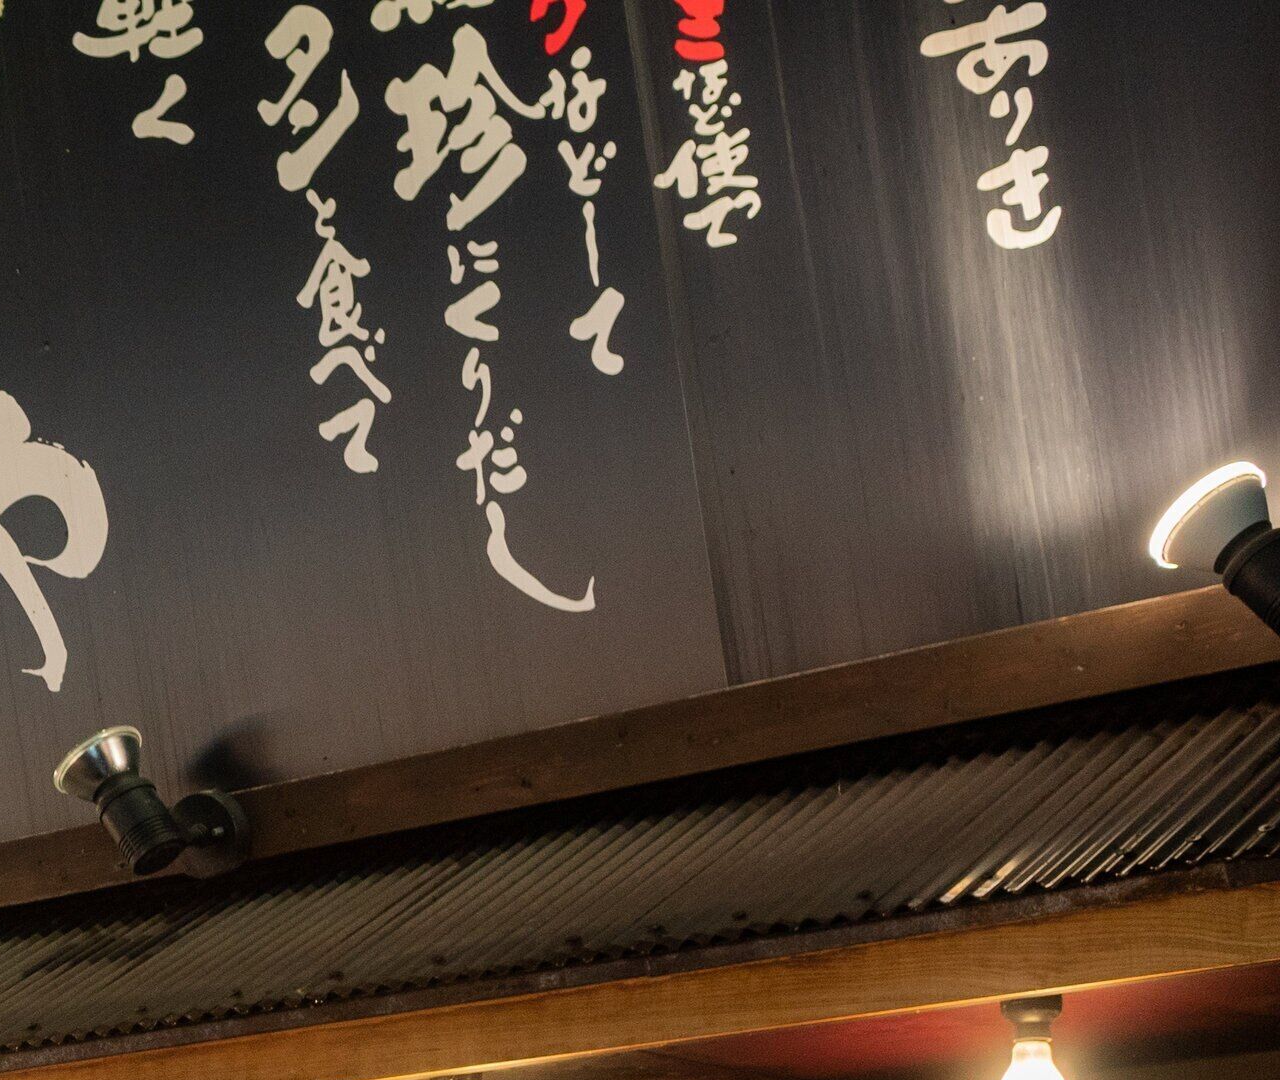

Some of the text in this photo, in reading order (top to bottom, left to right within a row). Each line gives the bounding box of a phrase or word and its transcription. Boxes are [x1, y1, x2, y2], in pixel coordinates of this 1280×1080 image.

[371, 0, 596, 612] 珍にくりだし
